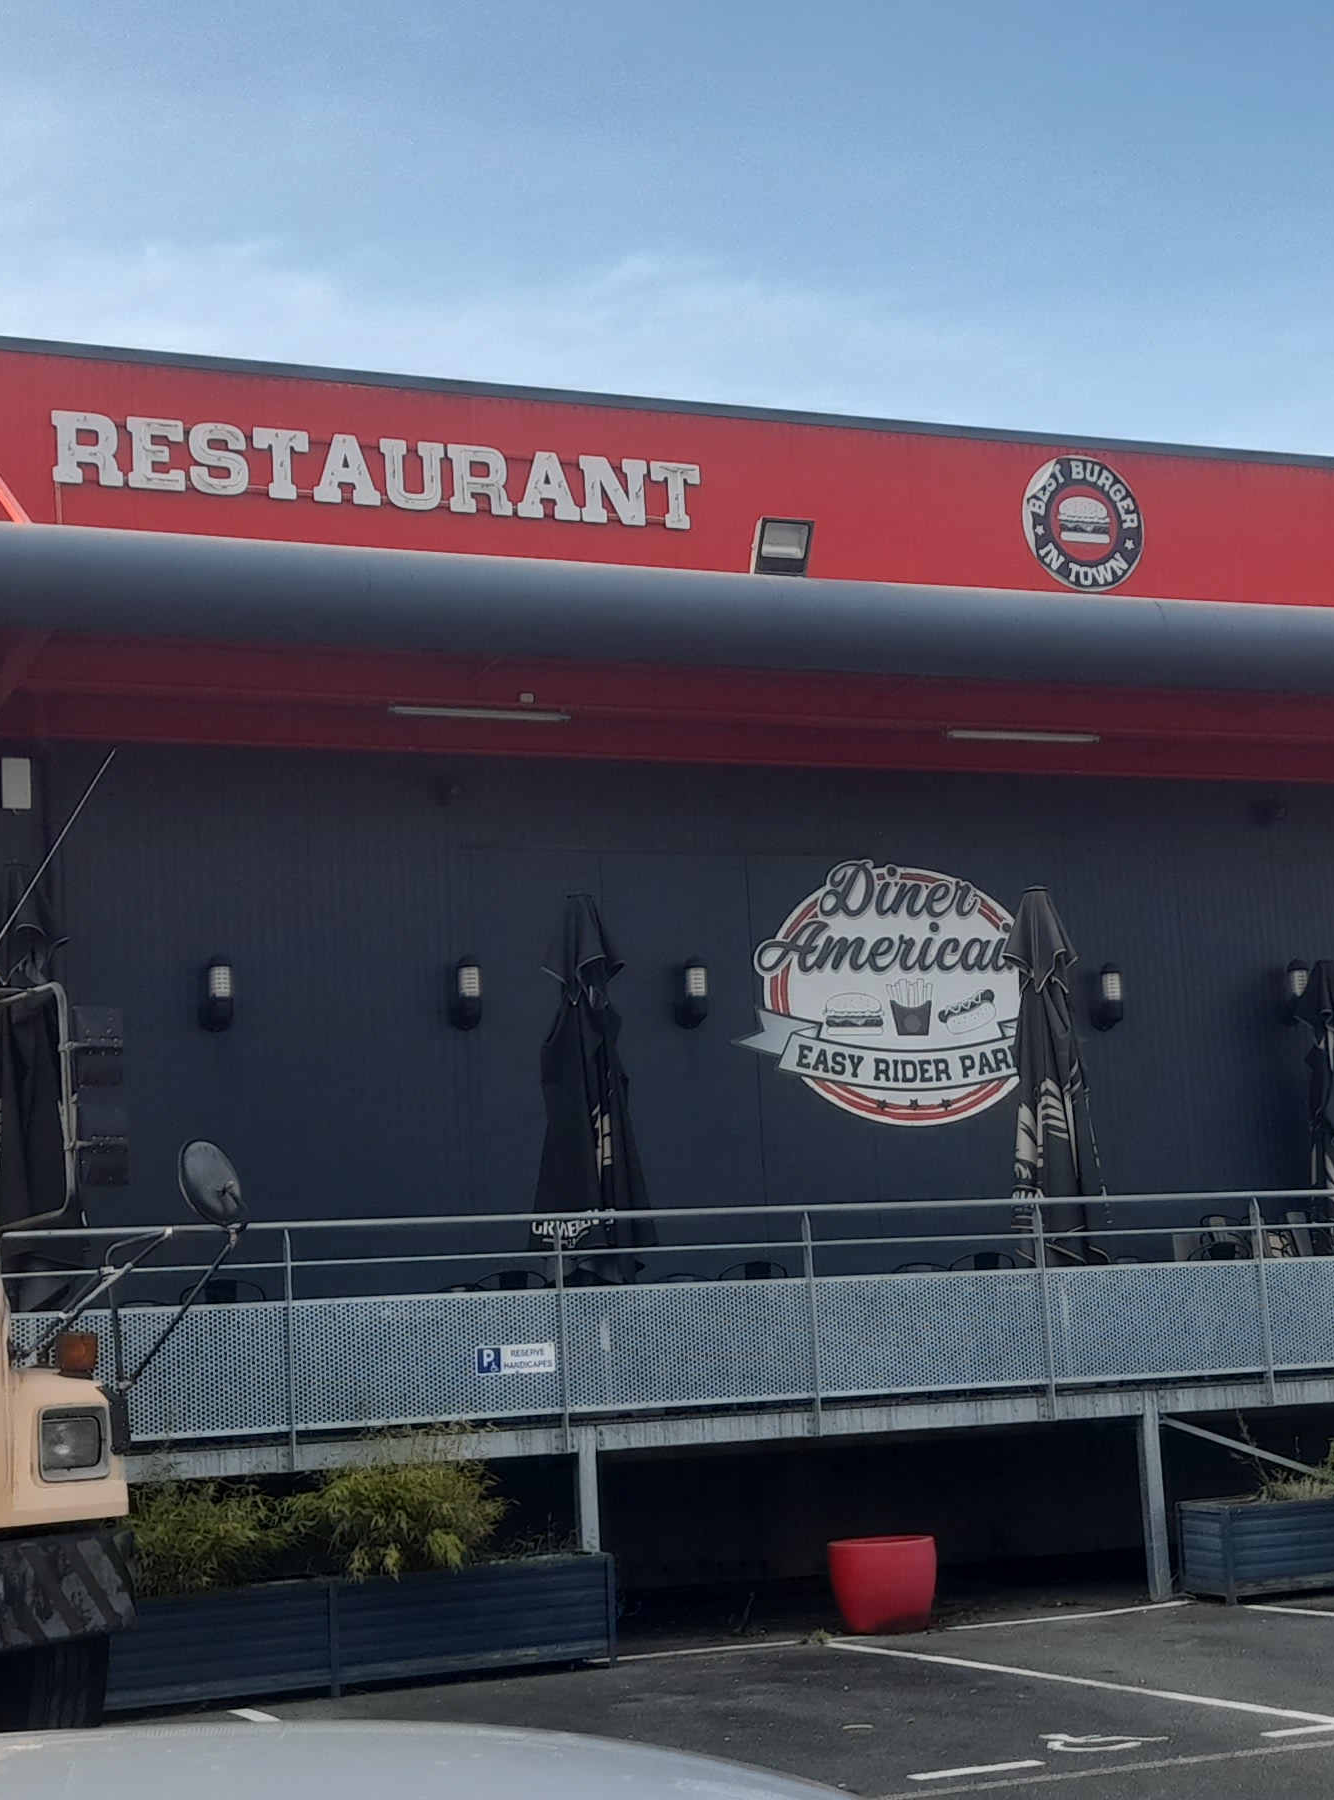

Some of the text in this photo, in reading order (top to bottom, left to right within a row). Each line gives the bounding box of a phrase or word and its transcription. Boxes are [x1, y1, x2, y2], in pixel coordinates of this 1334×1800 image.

[51, 409, 700, 529] RESTAURANT
[1027, 461, 1139, 530] BEST BURGER
[1039, 542, 1129, 586] IN TOWN
[820, 860, 980, 918] Diner
[796, 1045, 864, 1078] EASY
[874, 1057, 952, 1083] RIDER
